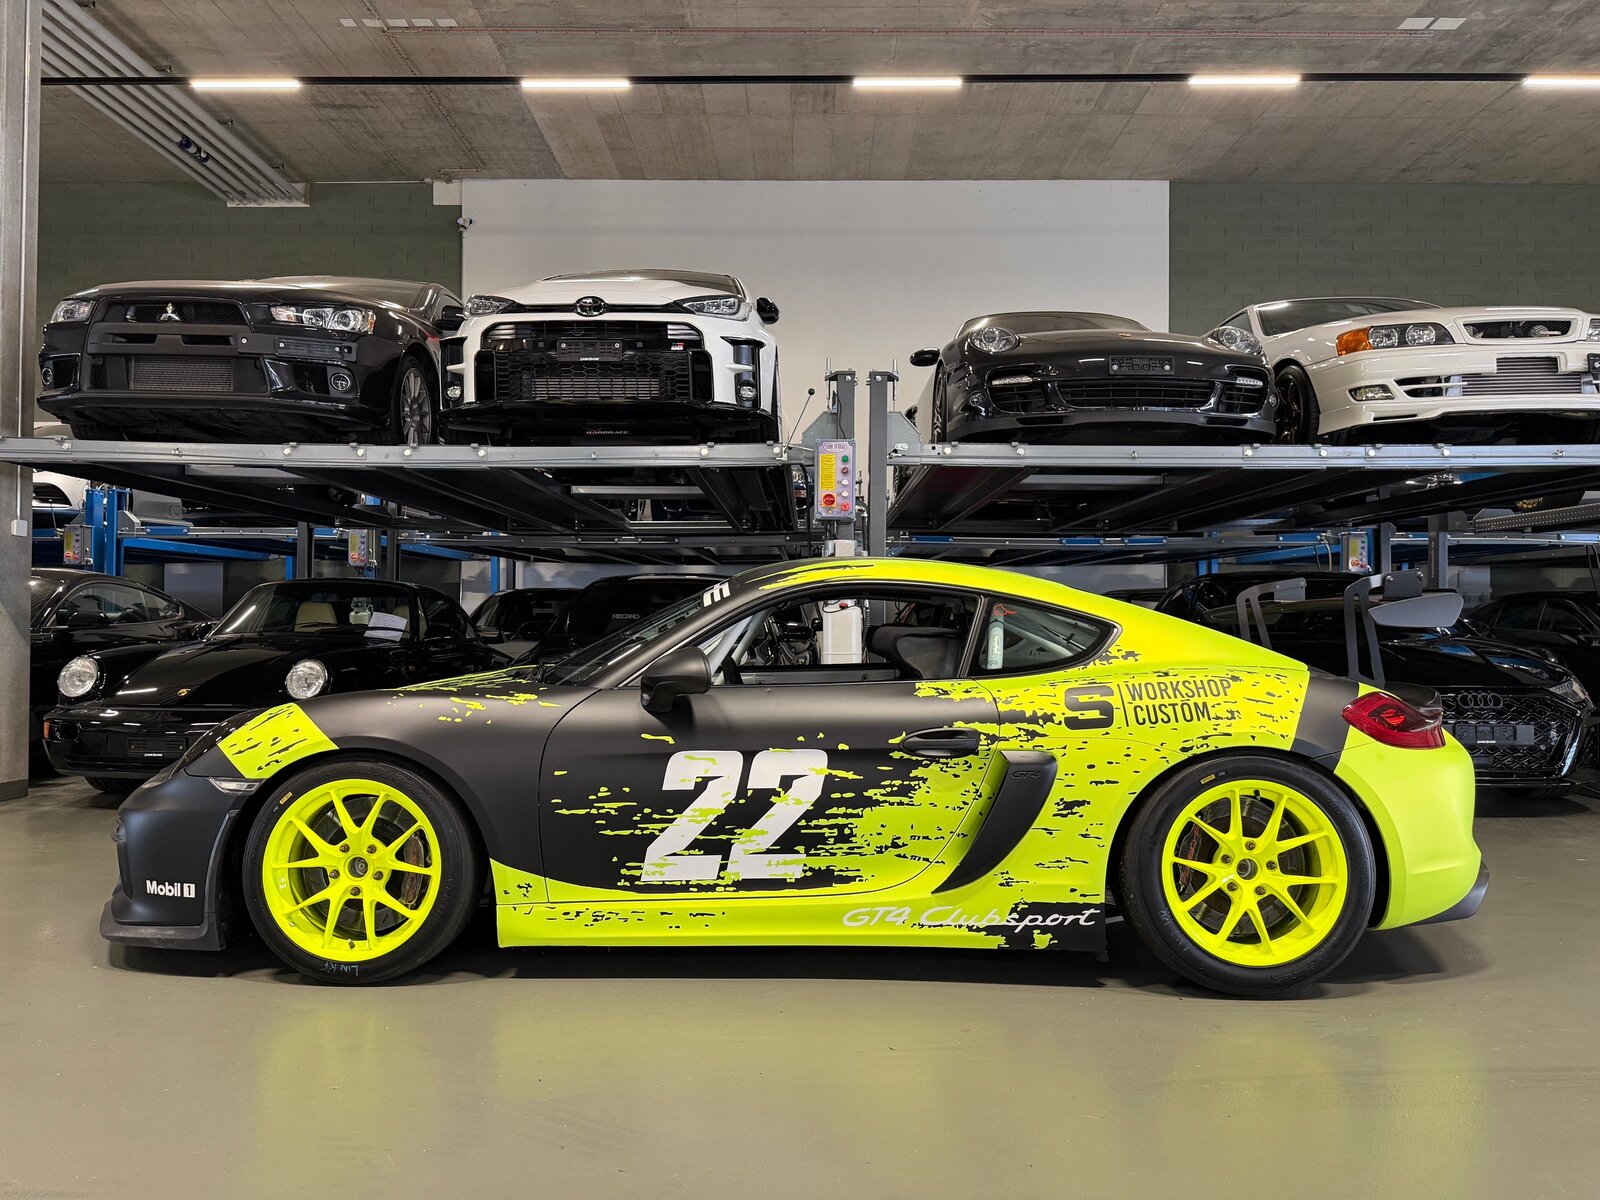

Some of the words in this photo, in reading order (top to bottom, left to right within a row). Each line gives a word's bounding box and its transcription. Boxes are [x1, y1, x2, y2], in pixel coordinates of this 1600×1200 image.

[1125, 678, 1232, 702] WORKSHOP
[1133, 701, 1213, 726] CUSTOM
[1012, 770, 1041, 779] GT4
[640, 748, 829, 882] 22
[146, 879, 181, 897] Mobil
[842, 906, 912, 927] GT4
[920, 906, 1101, 933] Clubsport
